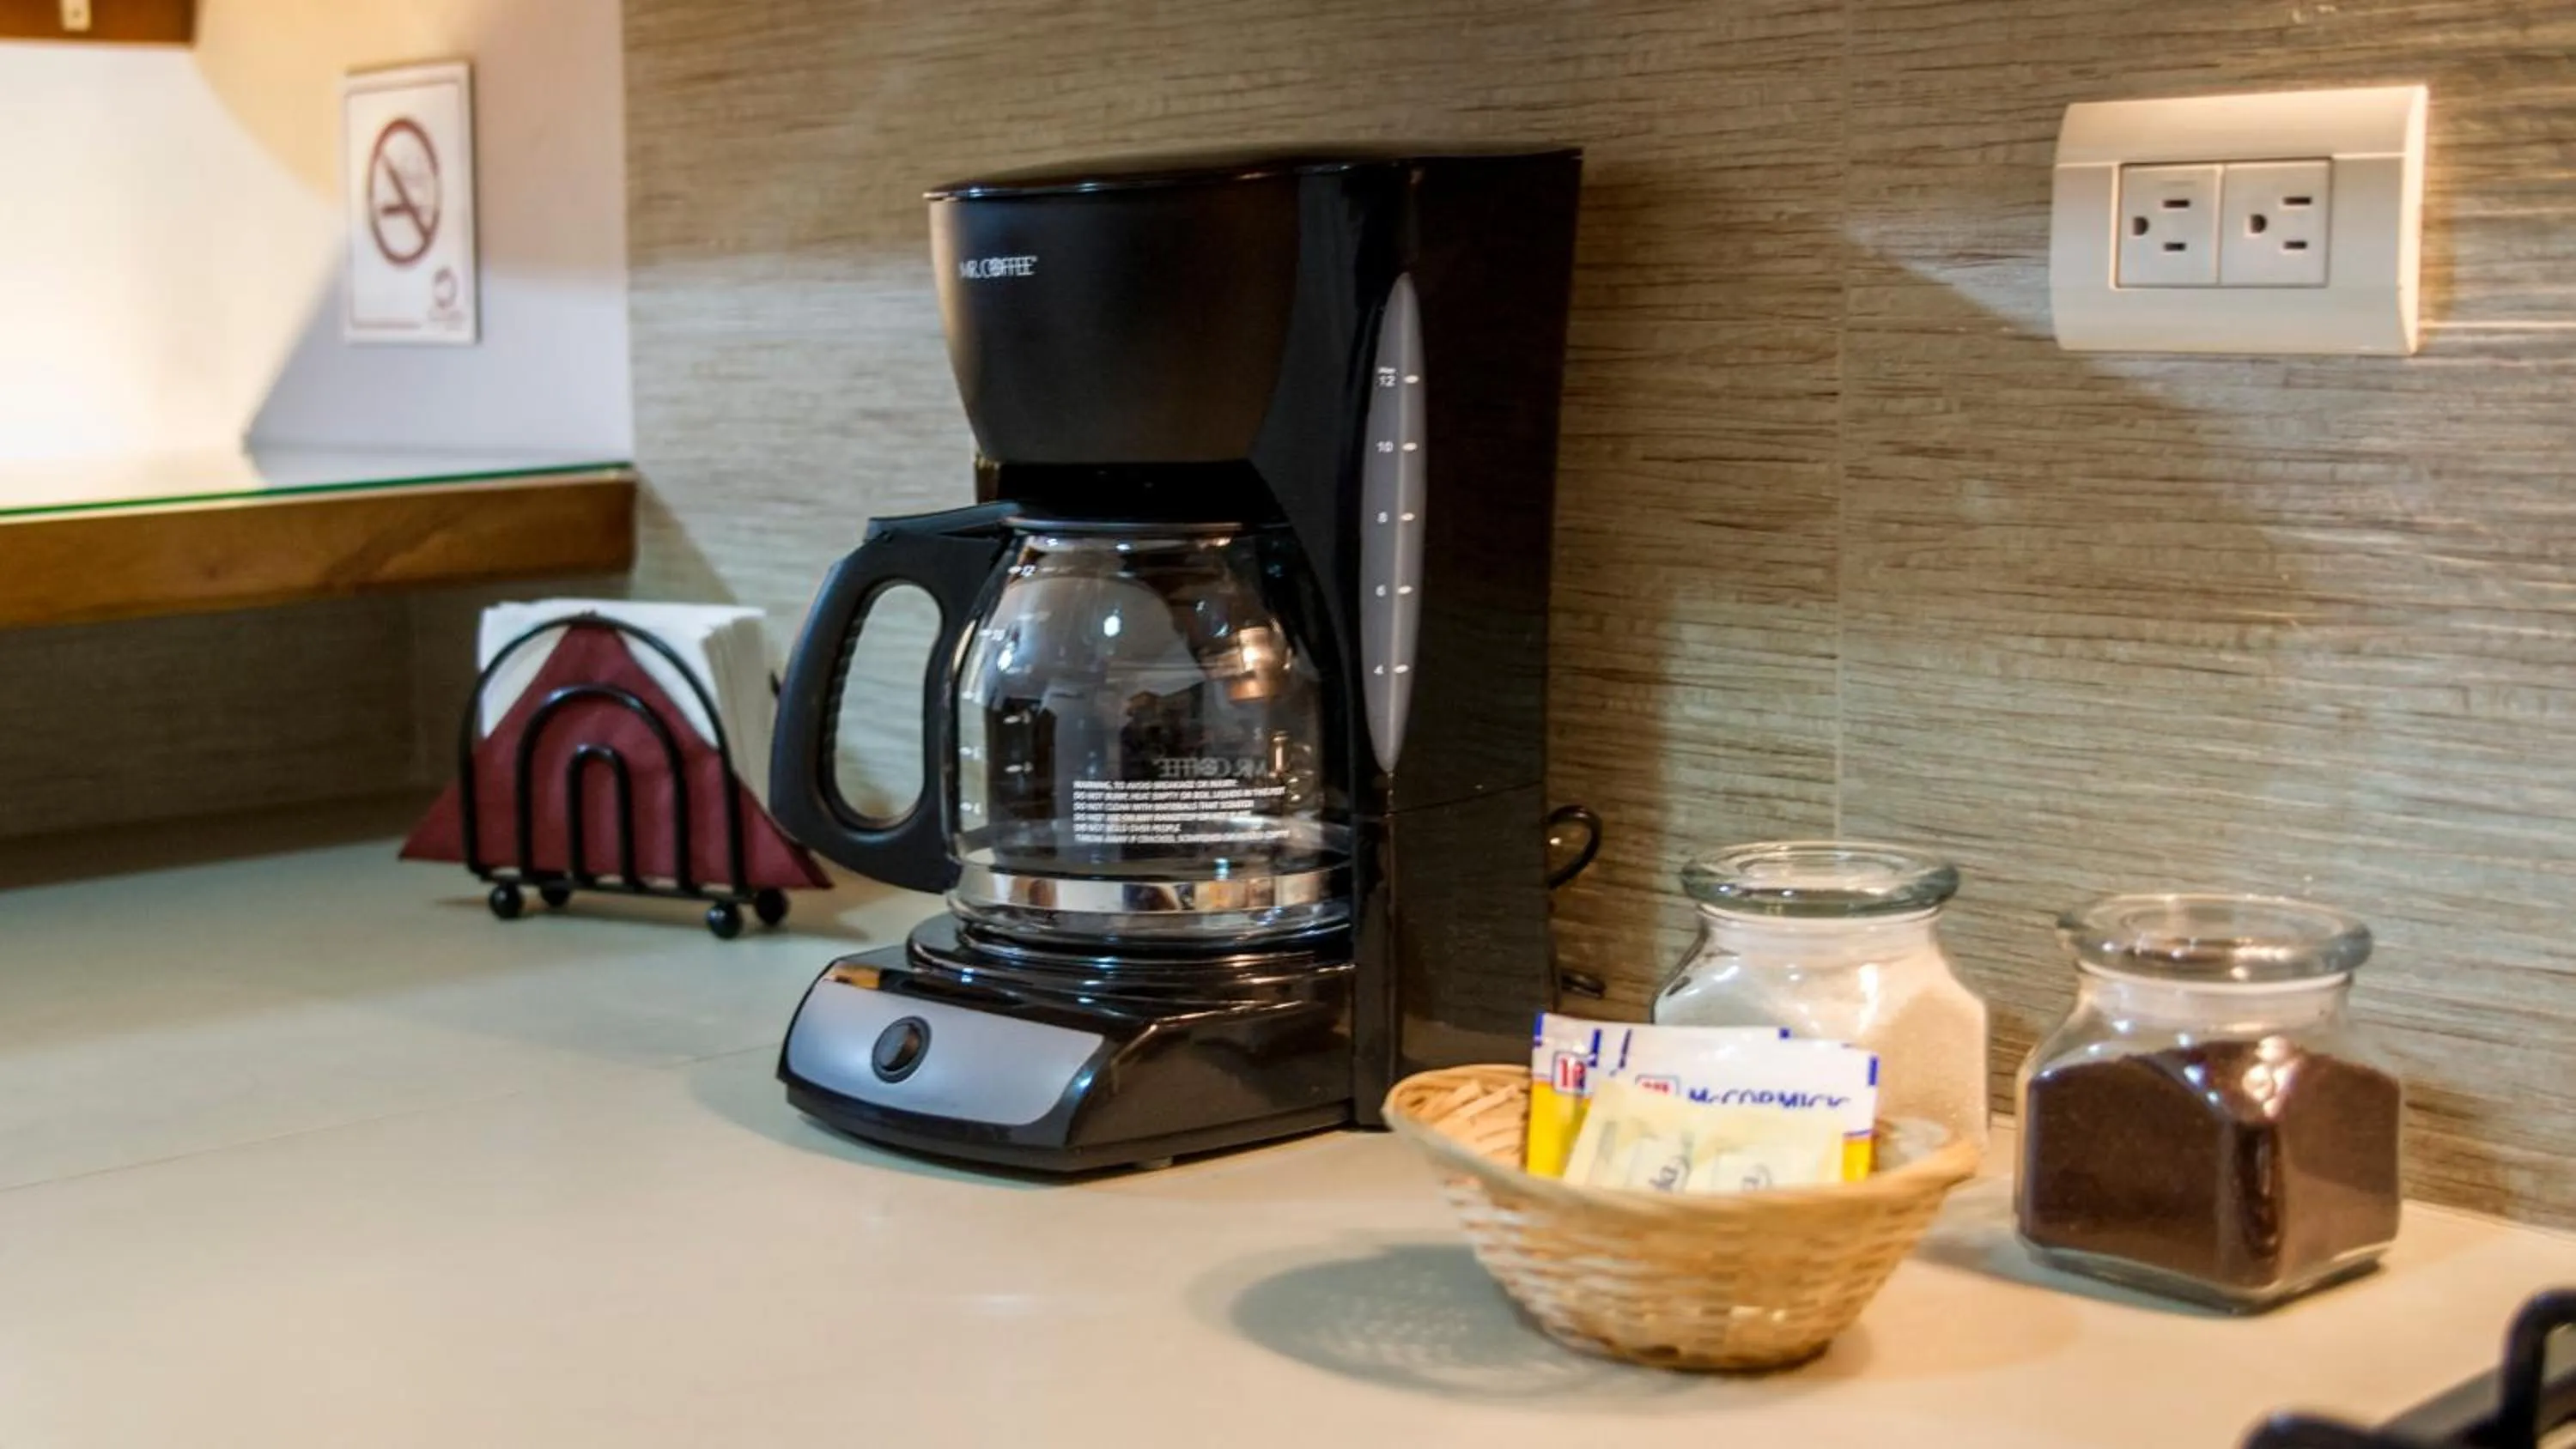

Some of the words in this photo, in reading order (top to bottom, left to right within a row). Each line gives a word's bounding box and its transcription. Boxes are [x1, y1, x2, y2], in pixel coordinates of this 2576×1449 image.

[1376, 441, 1394, 453] 10
[1376, 585, 1386, 597] 6
[1374, 664, 1383, 675] 4
